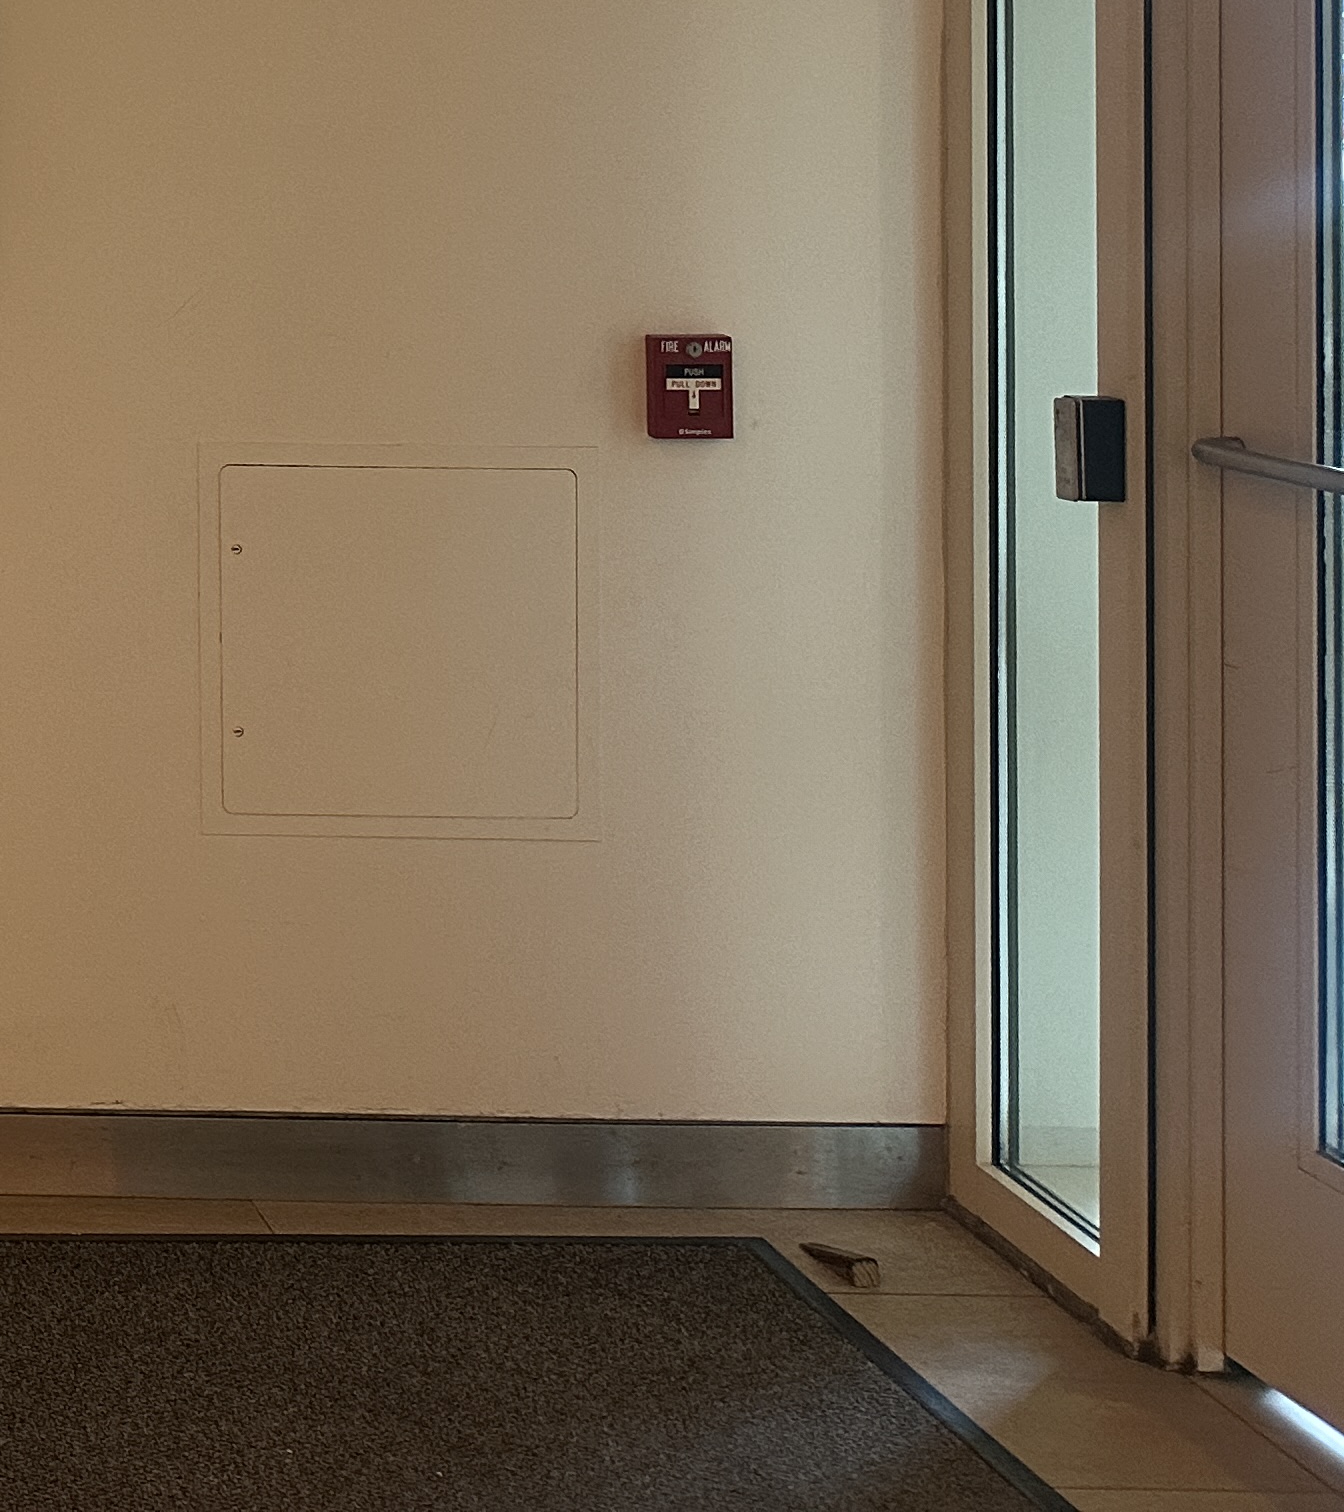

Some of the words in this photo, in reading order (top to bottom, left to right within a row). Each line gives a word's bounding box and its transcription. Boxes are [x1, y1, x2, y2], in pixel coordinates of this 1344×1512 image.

[661, 341, 679, 353] FIRE
[704, 341, 731, 352] ALARM
[684, 368, 705, 376] PUSH
[671, 380, 690, 388] PULL
[695, 380, 717, 388] DOWN
